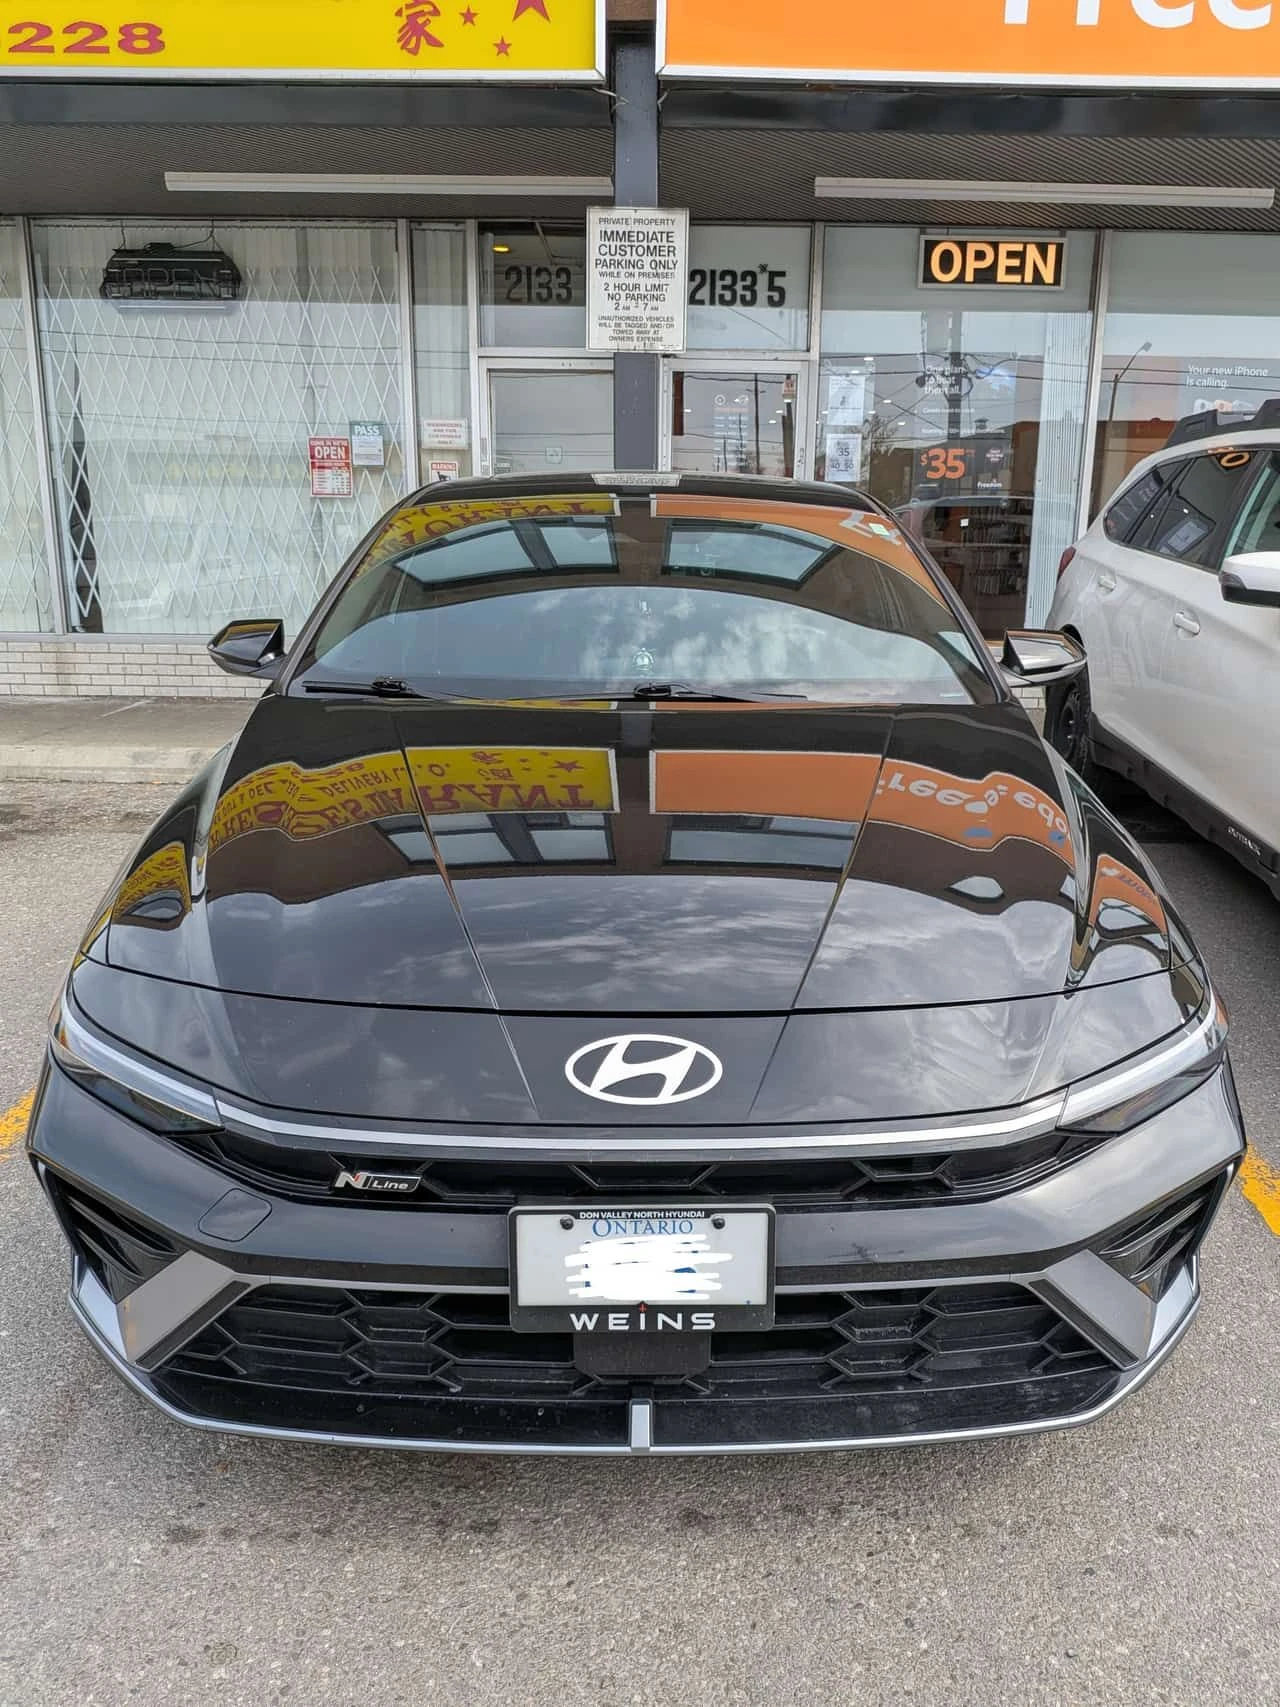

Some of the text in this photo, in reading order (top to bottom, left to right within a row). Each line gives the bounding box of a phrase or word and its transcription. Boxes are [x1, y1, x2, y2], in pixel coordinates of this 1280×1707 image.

[4, 21, 166, 55] 228
[598, 217, 676, 226] PRIVATE PROPERTY
[599, 230, 675, 243] IMMEDIATE
[598, 244, 677, 257] CUSTOMER
[595, 258, 678, 270] PARKING ONLY
[931, 241, 1057, 284] OPEN
[598, 271, 621, 279] WHILE
[638, 271, 674, 279] PREMISES
[504, 265, 572, 304] 2133
[604, 282, 670, 293] 2 HOUR LIMIT
[607, 293, 666, 302] NO PARKING
[614, 302, 620, 310] 2
[643, 302, 649, 311] 7
[1187, 364, 1269, 377] Your new iPhone
[354, 425, 380, 435] PASS
[314, 446, 345, 459] OPEN
[335, 1171, 409, 1190] N Line
[579, 1211, 600, 1220] DON
[600, 1211, 632, 1219] VALLEY
[633, 1211, 665, 1219] NORTH
